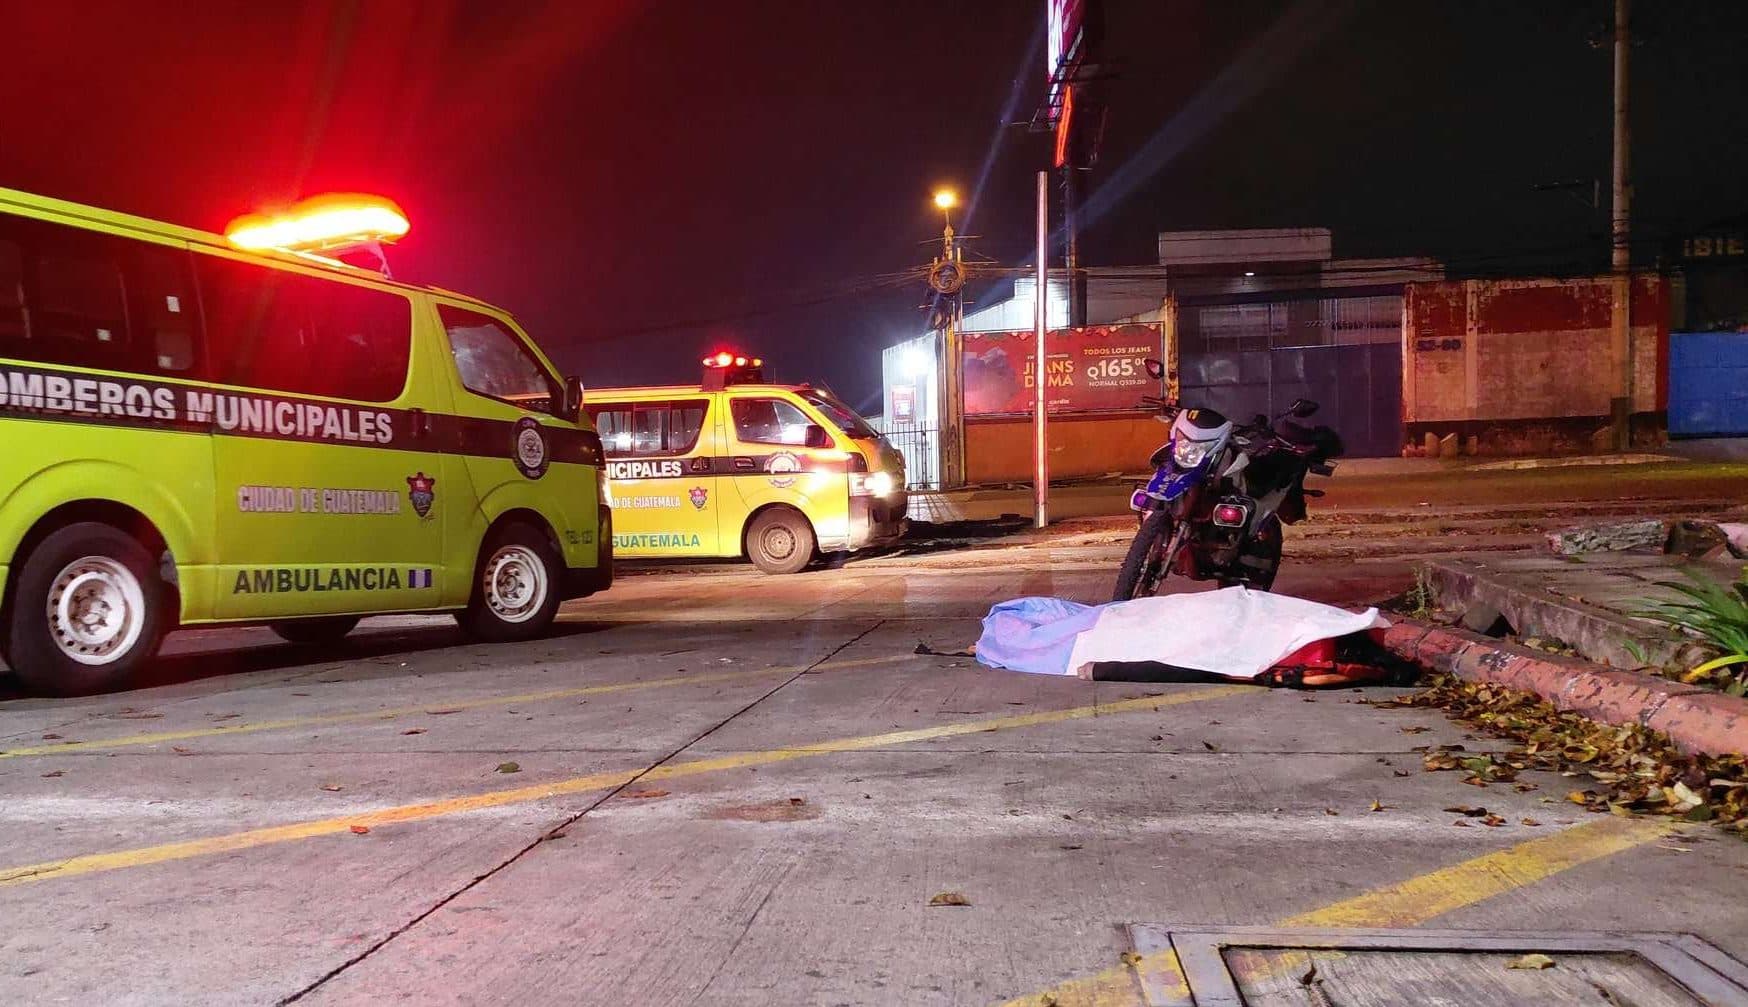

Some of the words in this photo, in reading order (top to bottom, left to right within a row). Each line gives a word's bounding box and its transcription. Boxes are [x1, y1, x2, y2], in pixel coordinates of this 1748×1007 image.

[1084, 348, 1110, 356] TODOS
[1111, 346, 1127, 354] LOS
[1127, 345, 1152, 354] JEANS
[1024, 374, 1074, 388] DMA
[186, 391, 393, 444] MUNICIPALES
[238, 485, 295, 513] CIUDAD
[300, 487, 319, 513] DE
[323, 488, 401, 515] GUATEMALA
[634, 496, 681, 507] GUATEMALA
[612, 535, 700, 548] GUATEMALA
[233, 567, 402, 594] AMBULANCIA
